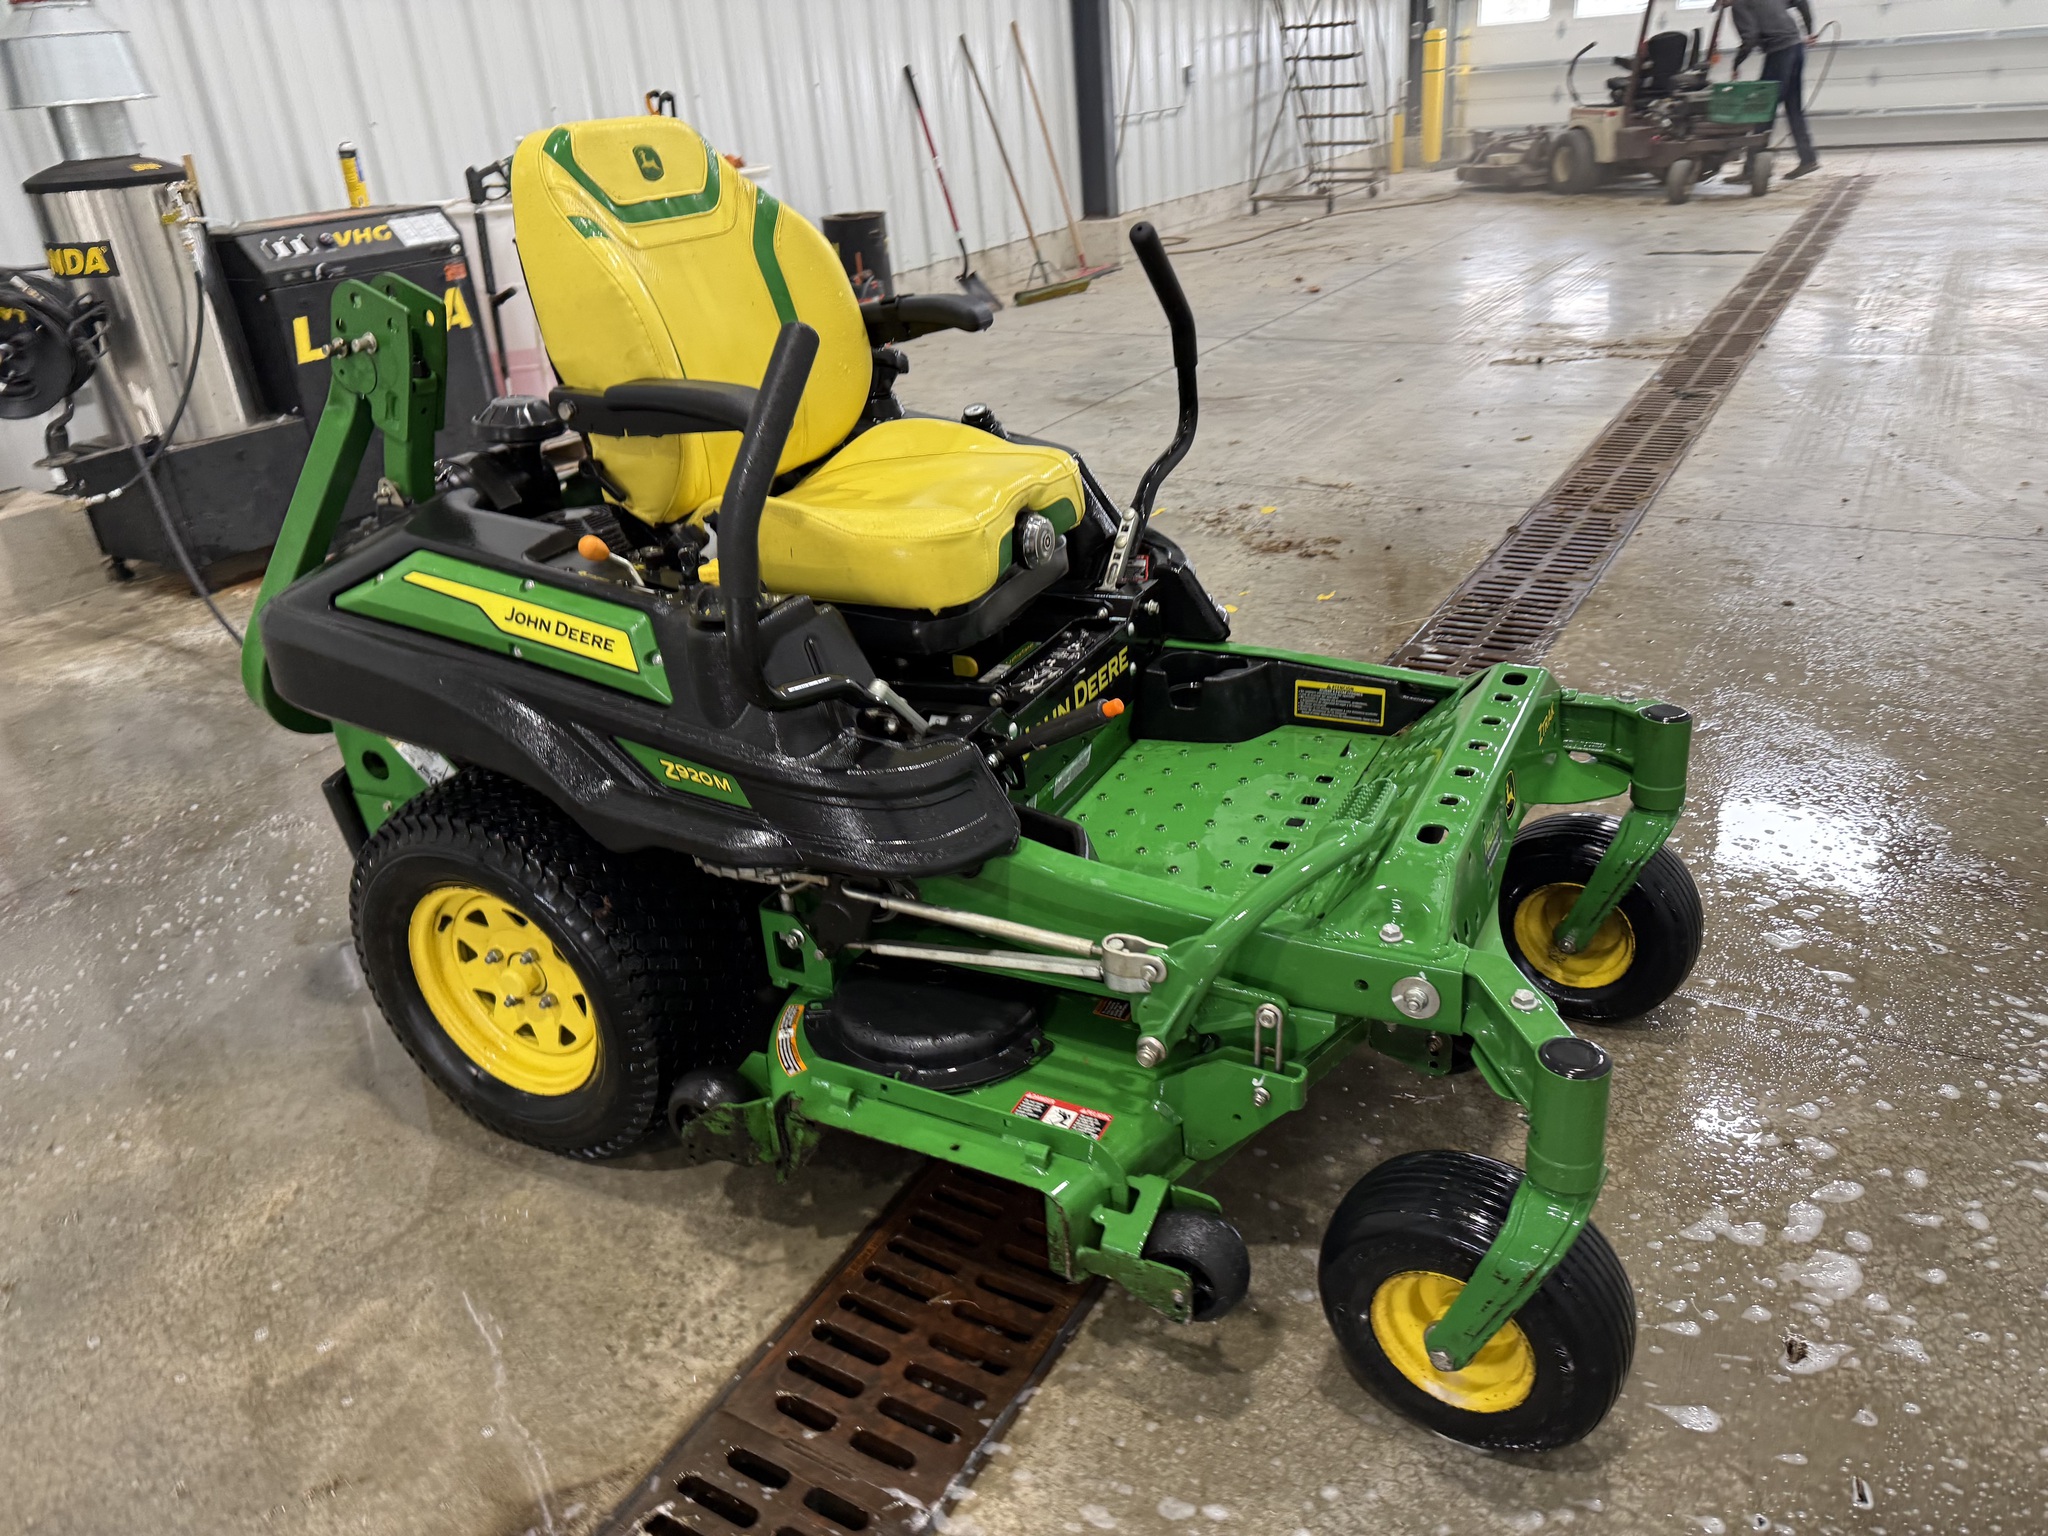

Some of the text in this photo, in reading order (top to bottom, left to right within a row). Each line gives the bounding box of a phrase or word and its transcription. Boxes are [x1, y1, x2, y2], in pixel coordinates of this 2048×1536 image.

[504, 606, 616, 652] JOHN DEERE
[1073, 645, 1129, 710] DEERE
[658, 758, 733, 793] Z920M
